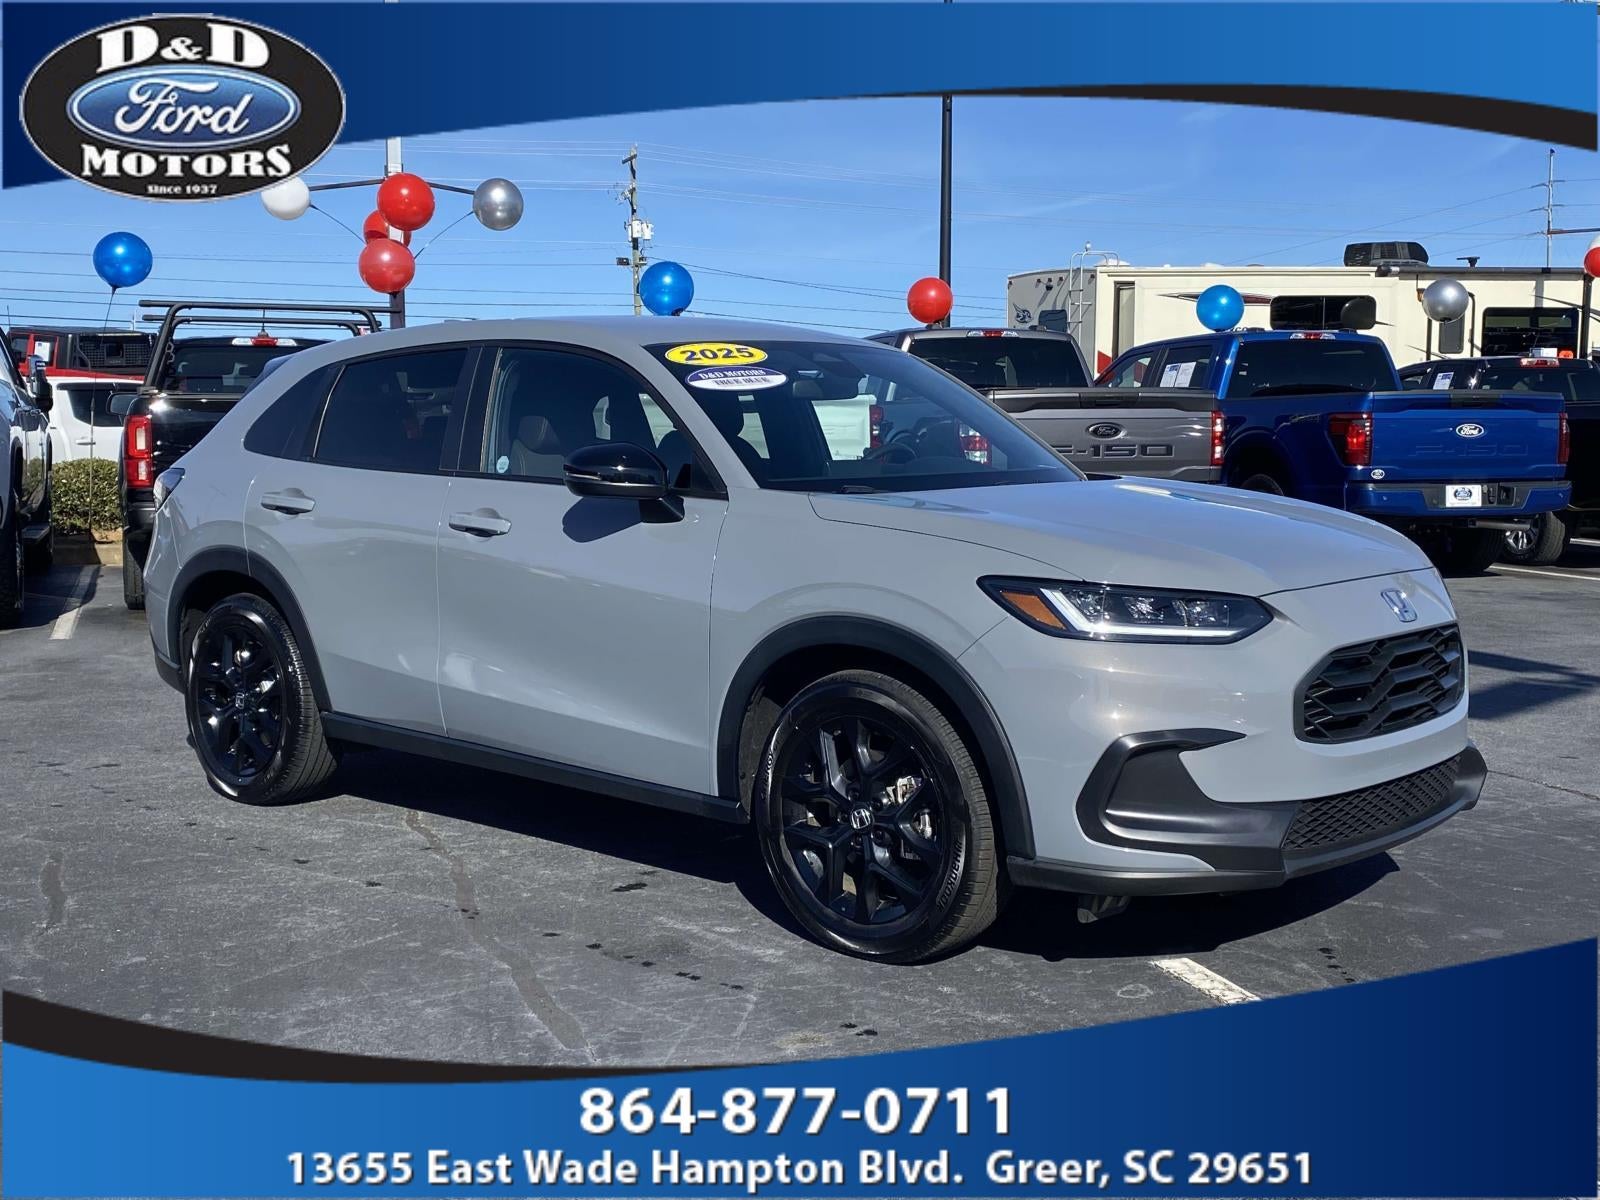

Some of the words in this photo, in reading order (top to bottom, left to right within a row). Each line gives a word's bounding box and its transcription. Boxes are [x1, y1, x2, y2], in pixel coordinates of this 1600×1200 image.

[680, 348, 754, 362] 2025
[698, 372, 724, 380] D&D
[725, 369, 767, 378] MOTORS
[714, 378, 741, 386] TRUE
[1460, 425, 1480, 436] Ford
